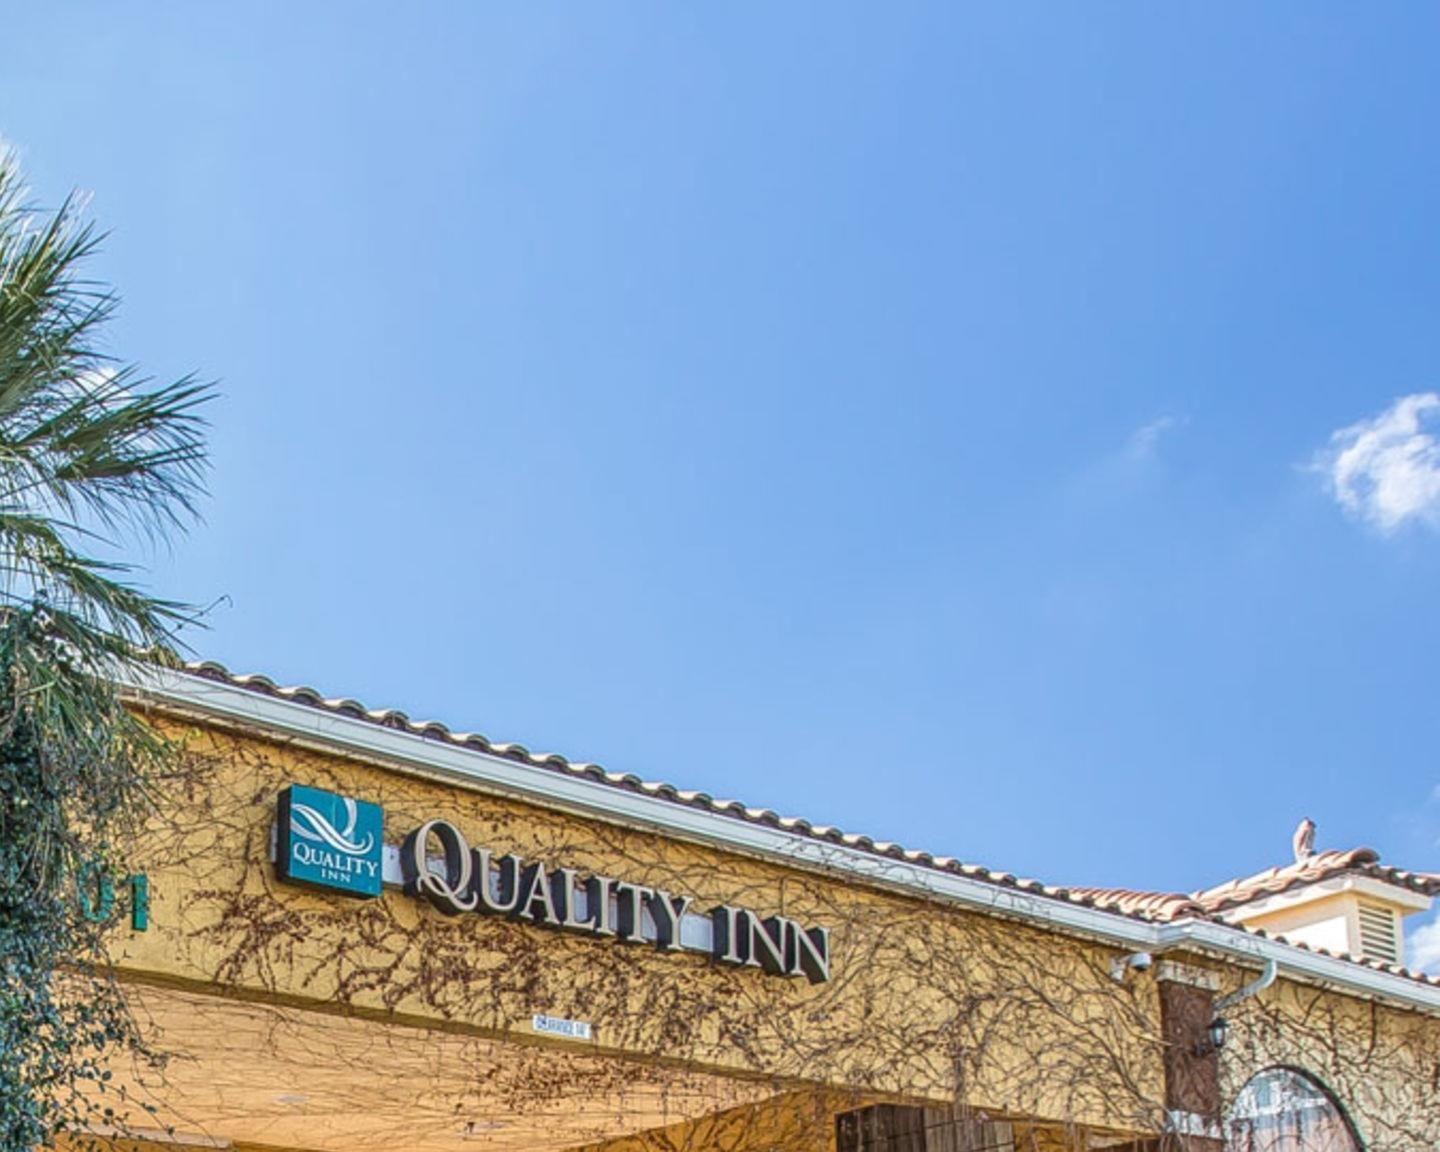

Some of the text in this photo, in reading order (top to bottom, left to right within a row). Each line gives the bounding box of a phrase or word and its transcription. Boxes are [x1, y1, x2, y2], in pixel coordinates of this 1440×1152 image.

[293, 842, 378, 878] QUALITY
[321, 868, 352, 884] INN
[412, 818, 831, 983] QUALITY INN
